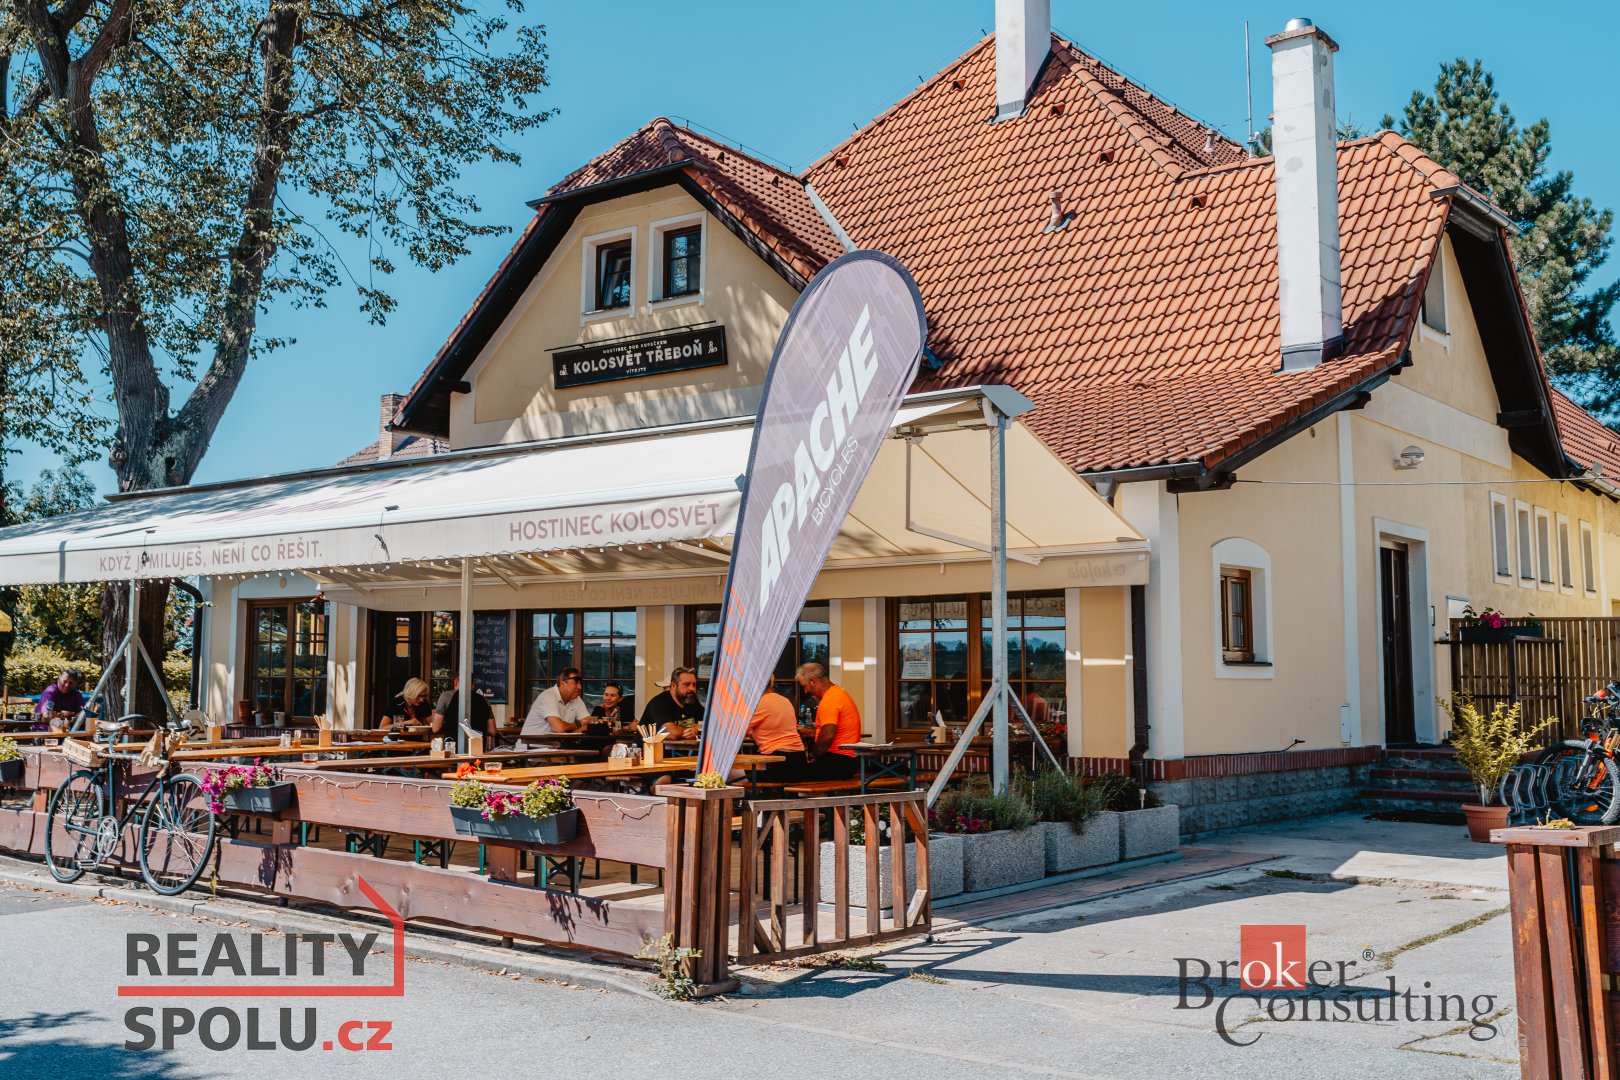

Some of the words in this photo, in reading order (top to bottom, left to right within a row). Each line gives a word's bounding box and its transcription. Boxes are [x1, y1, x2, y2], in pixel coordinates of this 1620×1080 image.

[573, 350, 642, 375] KOLOSVĚT
[646, 338, 703, 363] TŘEBOŇ
[602, 346, 627, 354] HOSTINEC
[759, 303, 879, 616] APACHE
[811, 435, 858, 527] BICYCLES
[509, 514, 604, 542] HOSTINEC
[610, 500, 720, 533] KOLOSVĚT
[99, 550, 131, 572] KDYŽ
[212, 541, 246, 565] NENÍ
[251, 544, 271, 562] CO
[277, 536, 323, 561] ŘEŠIT.
